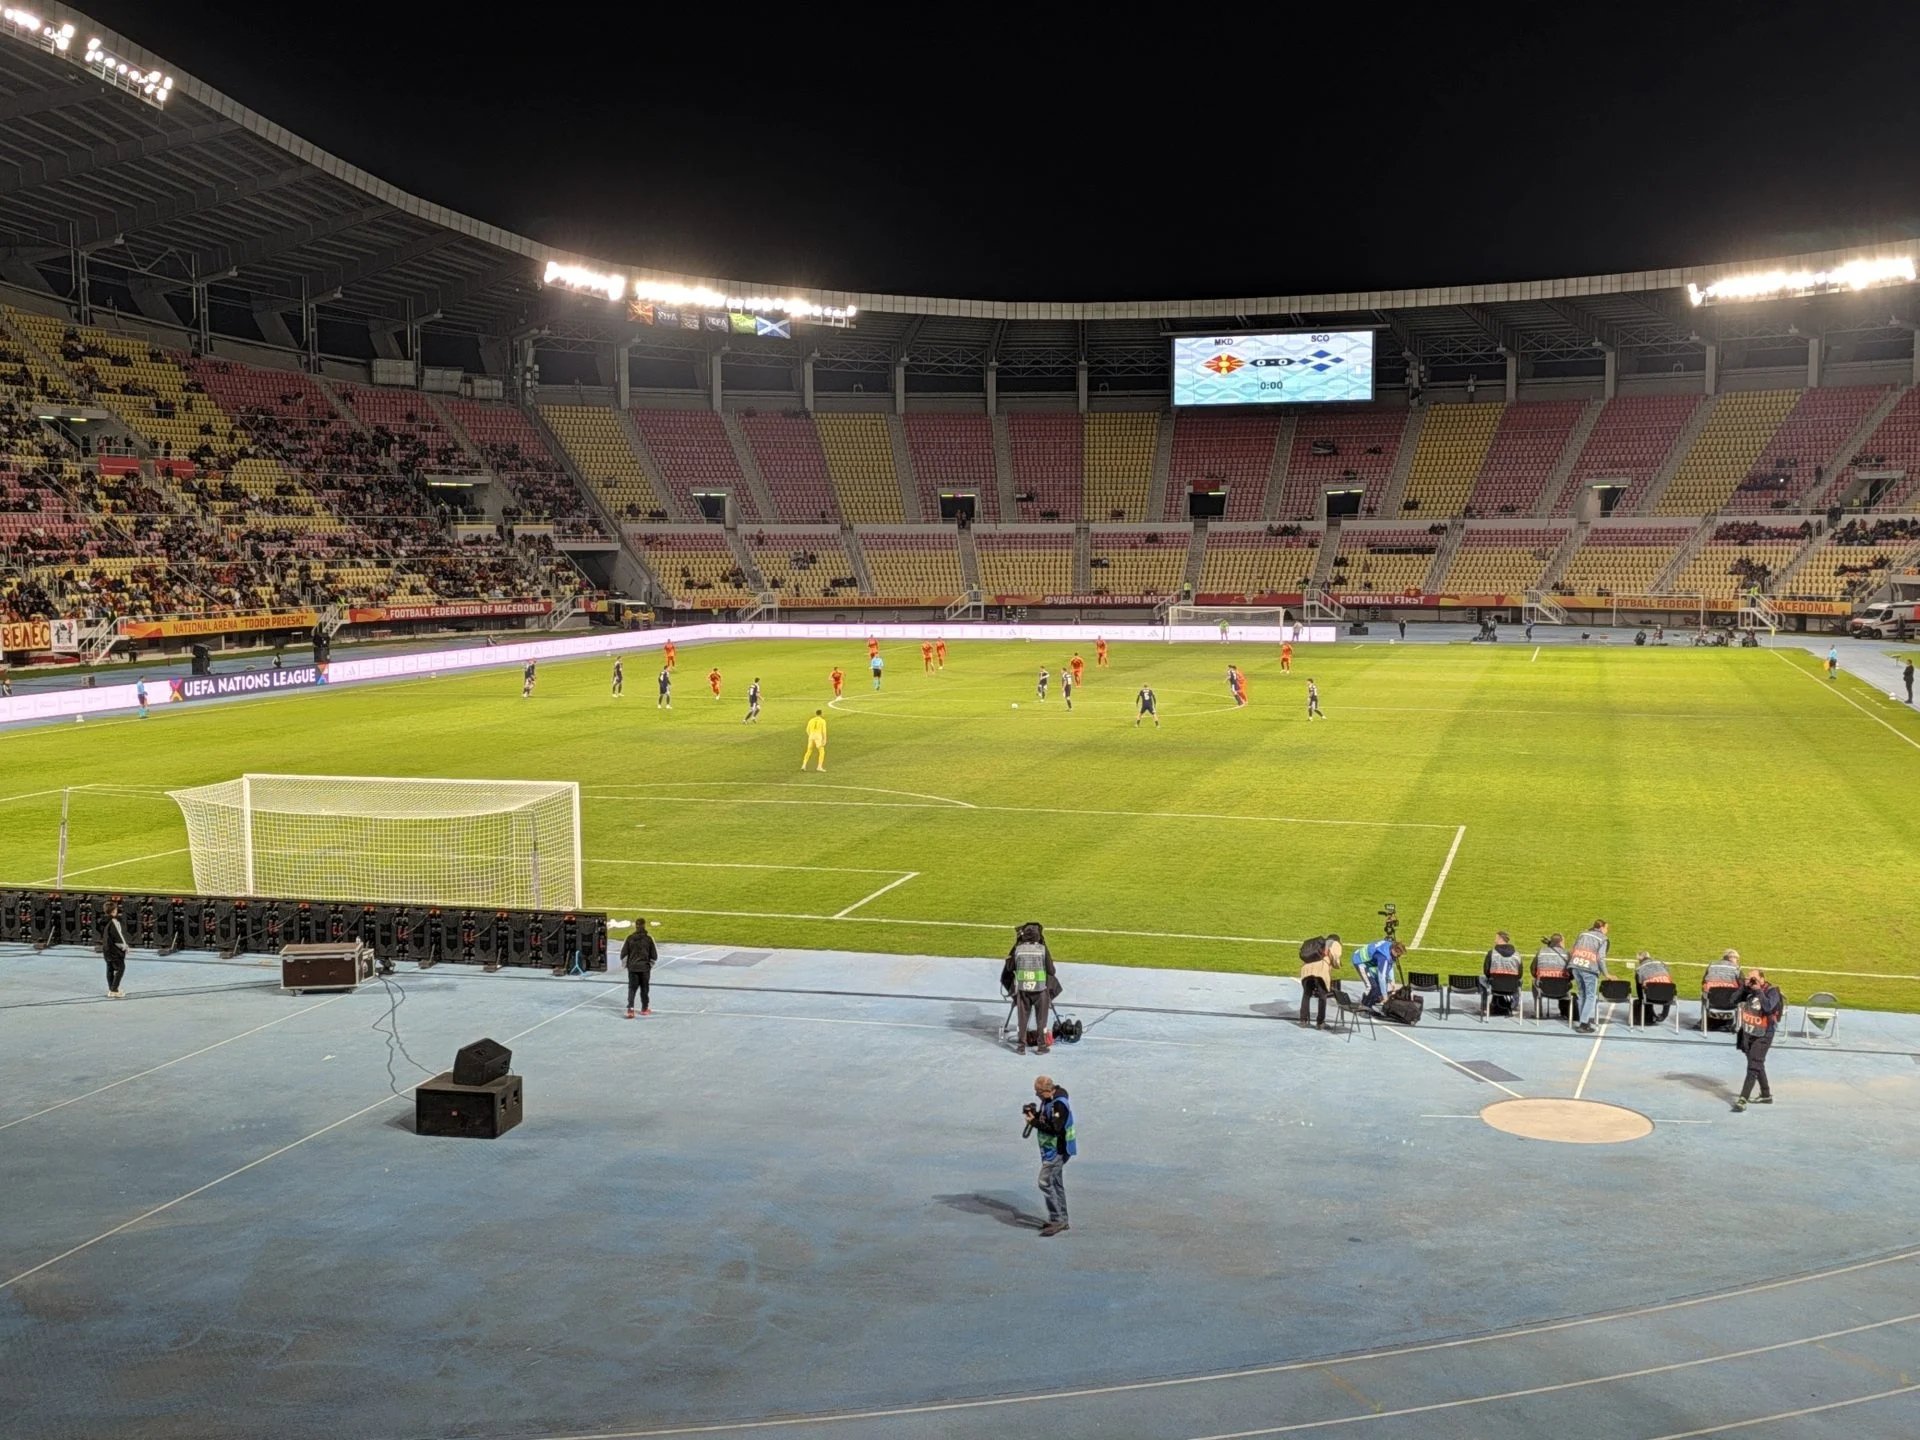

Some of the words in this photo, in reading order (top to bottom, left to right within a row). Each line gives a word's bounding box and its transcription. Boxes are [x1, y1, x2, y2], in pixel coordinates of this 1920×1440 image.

[1214, 338, 1233, 346] MKD
[1256, 359, 1266, 367] 0
[1278, 358, 1288, 366] 0
[1260, 381, 1283, 390] 0:00
[780, 599, 840, 607] ФЕДЕРАЦИЈА
[843, 598, 855, 606] НА
[857, 597, 921, 606] МАКЕДОНИЈА
[1044, 595, 1096, 605] ФУДБАЛОТ
[1099, 596, 1112, 605] НА
[1114, 595, 1140, 604] ПРВО
[1340, 595, 1392, 604] FOOTBALL
[1657, 599, 1717, 610] FEDERATON
[1721, 600, 1734, 610] OF
[390, 608, 429, 619] FOOTBALL
[430, 606, 481, 616] FEDERATION
[482, 605, 493, 614] OF
[494, 603, 545, 613] MACEDONIA
[173, 622, 213, 634] NATIONAL
[214, 620, 237, 631] ARENA
[184, 679, 216, 697] UEFA
[218, 673, 270, 692] NATIONS
[273, 668, 316, 687] LEAGUE
[1573, 957, 1590, 968] 052
